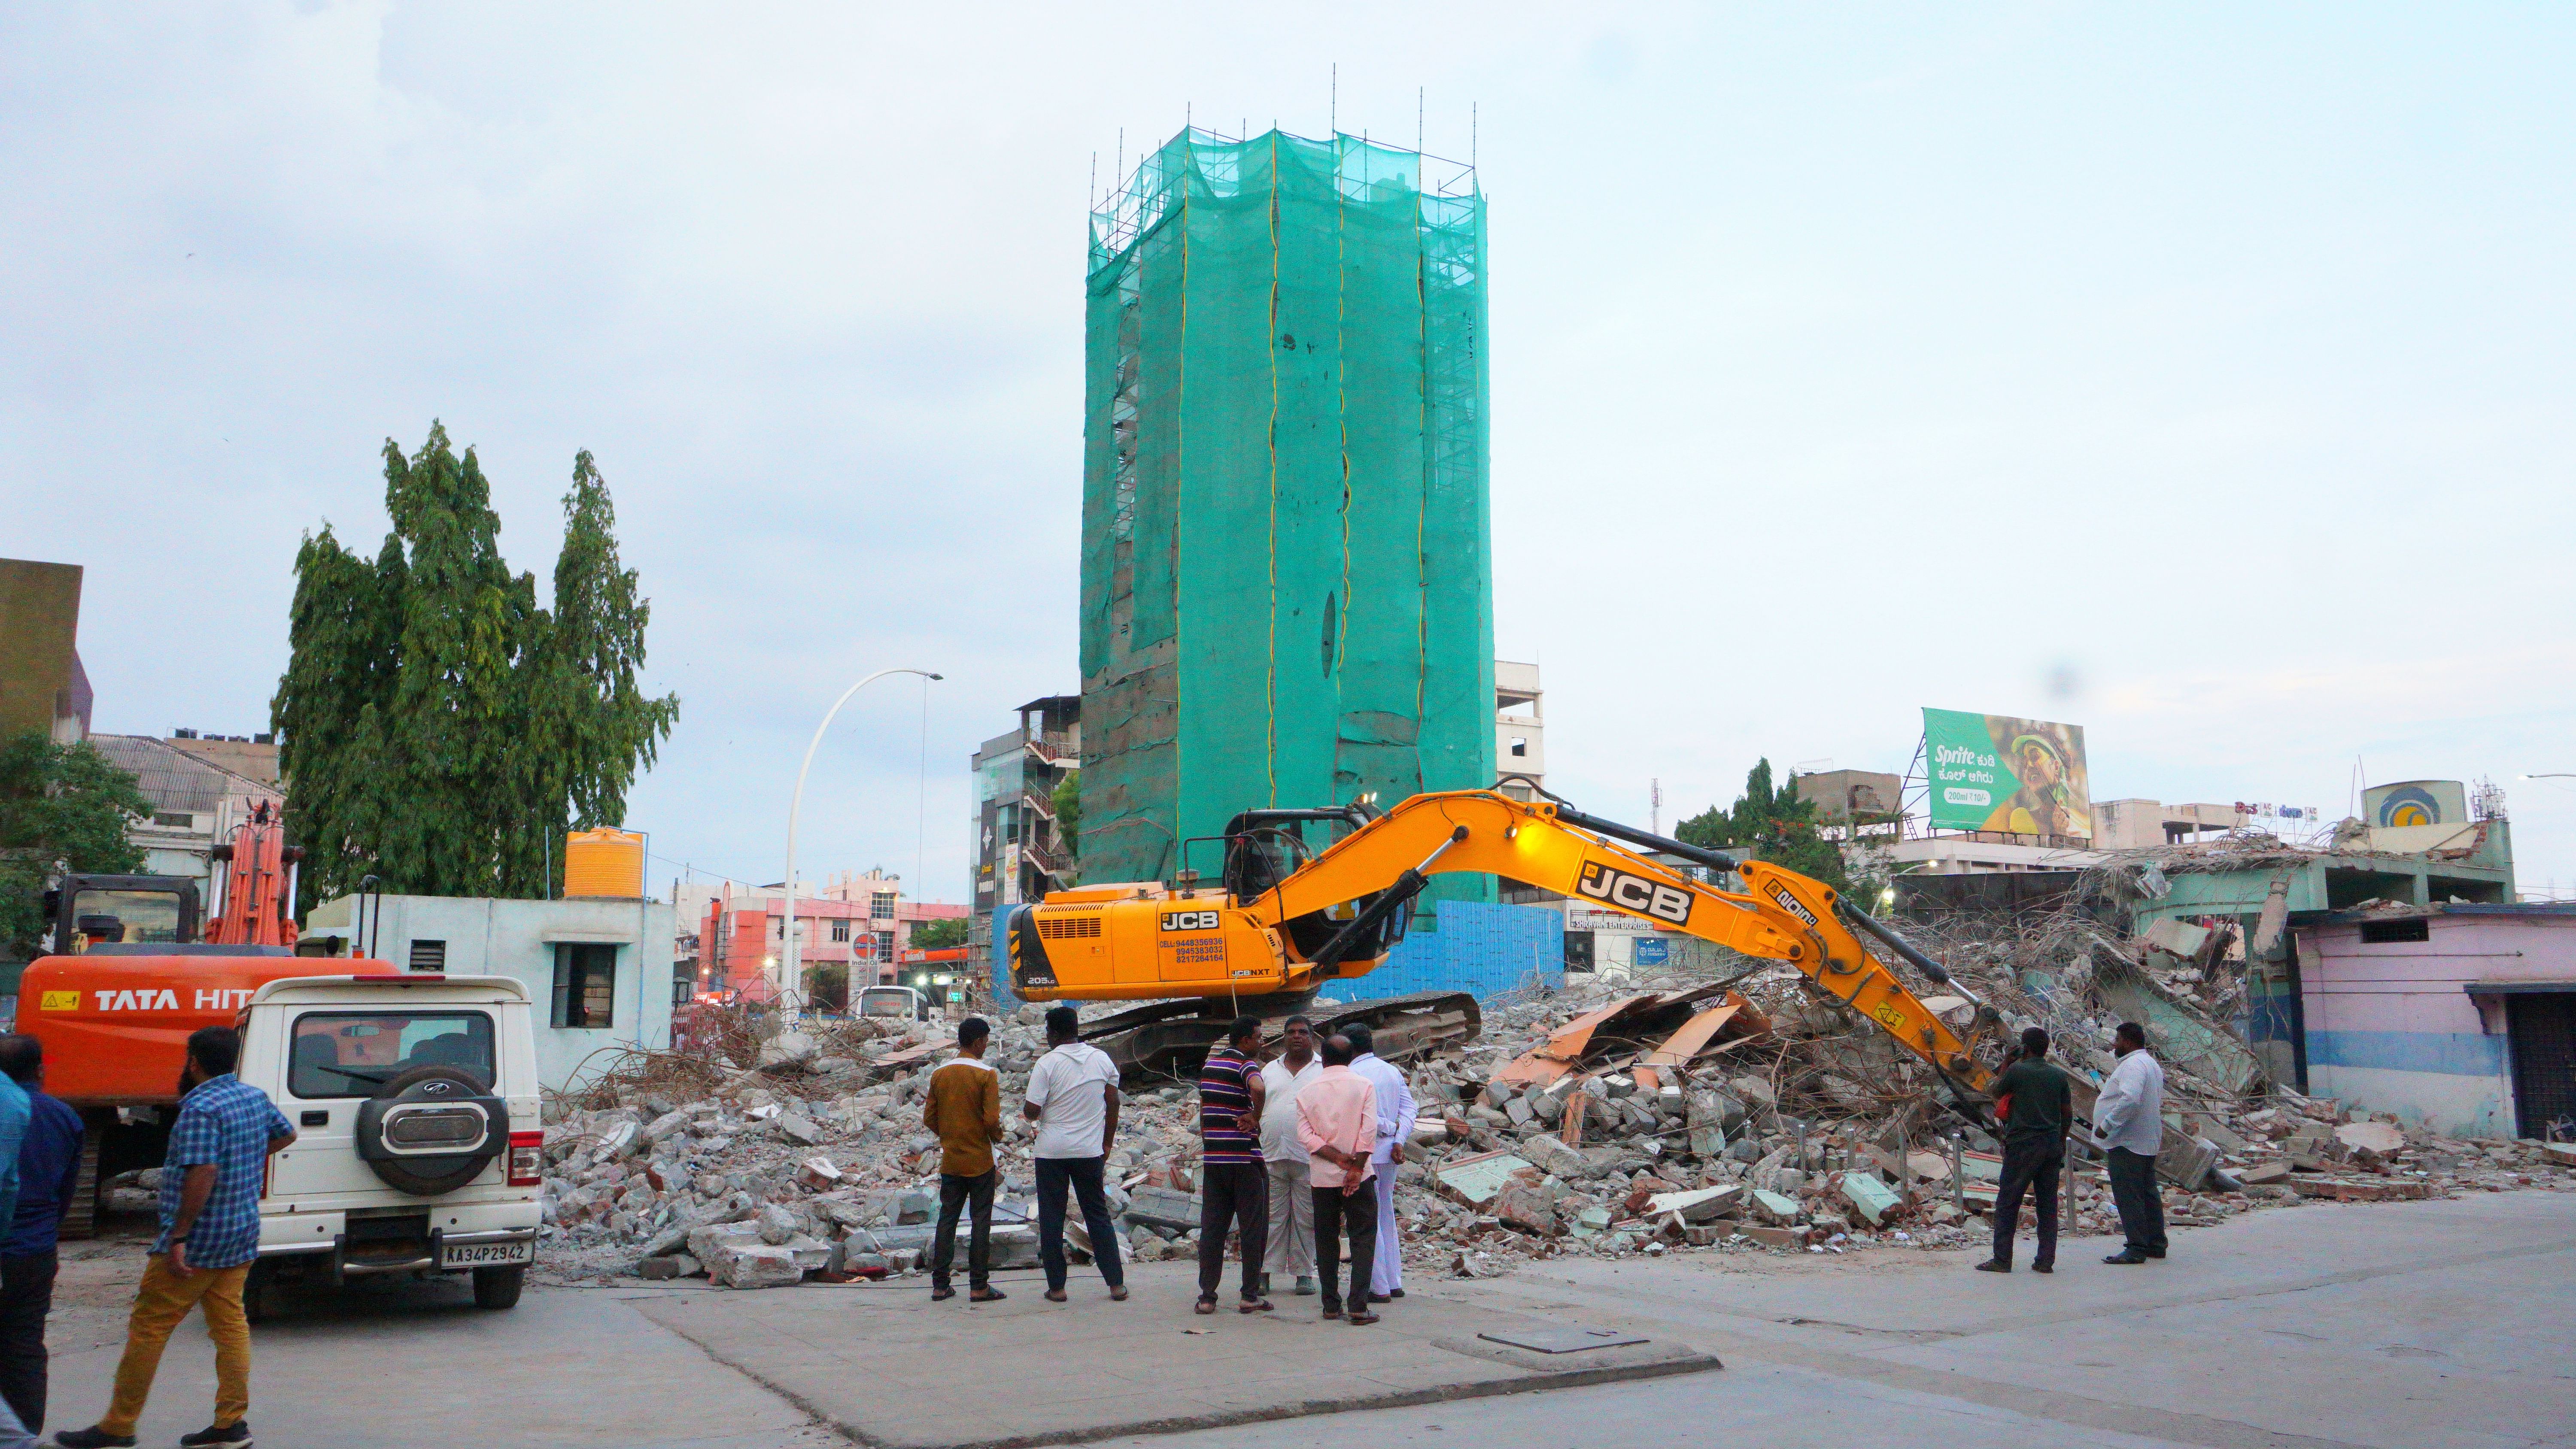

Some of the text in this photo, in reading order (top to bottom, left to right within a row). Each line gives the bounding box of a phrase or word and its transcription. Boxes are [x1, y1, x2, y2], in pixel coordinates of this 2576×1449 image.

[1935, 745, 1975, 767] Sprite
[1948, 791, 1968, 801] 200ml
[1581, 869, 1690, 922] JCB
[1162, 912, 1218, 930] JCB
[1610, 921, 1649, 930] ENTERPRISES
[95, 989, 179, 1011] TATA
[447, 1246, 524, 1263] KA34P2942
